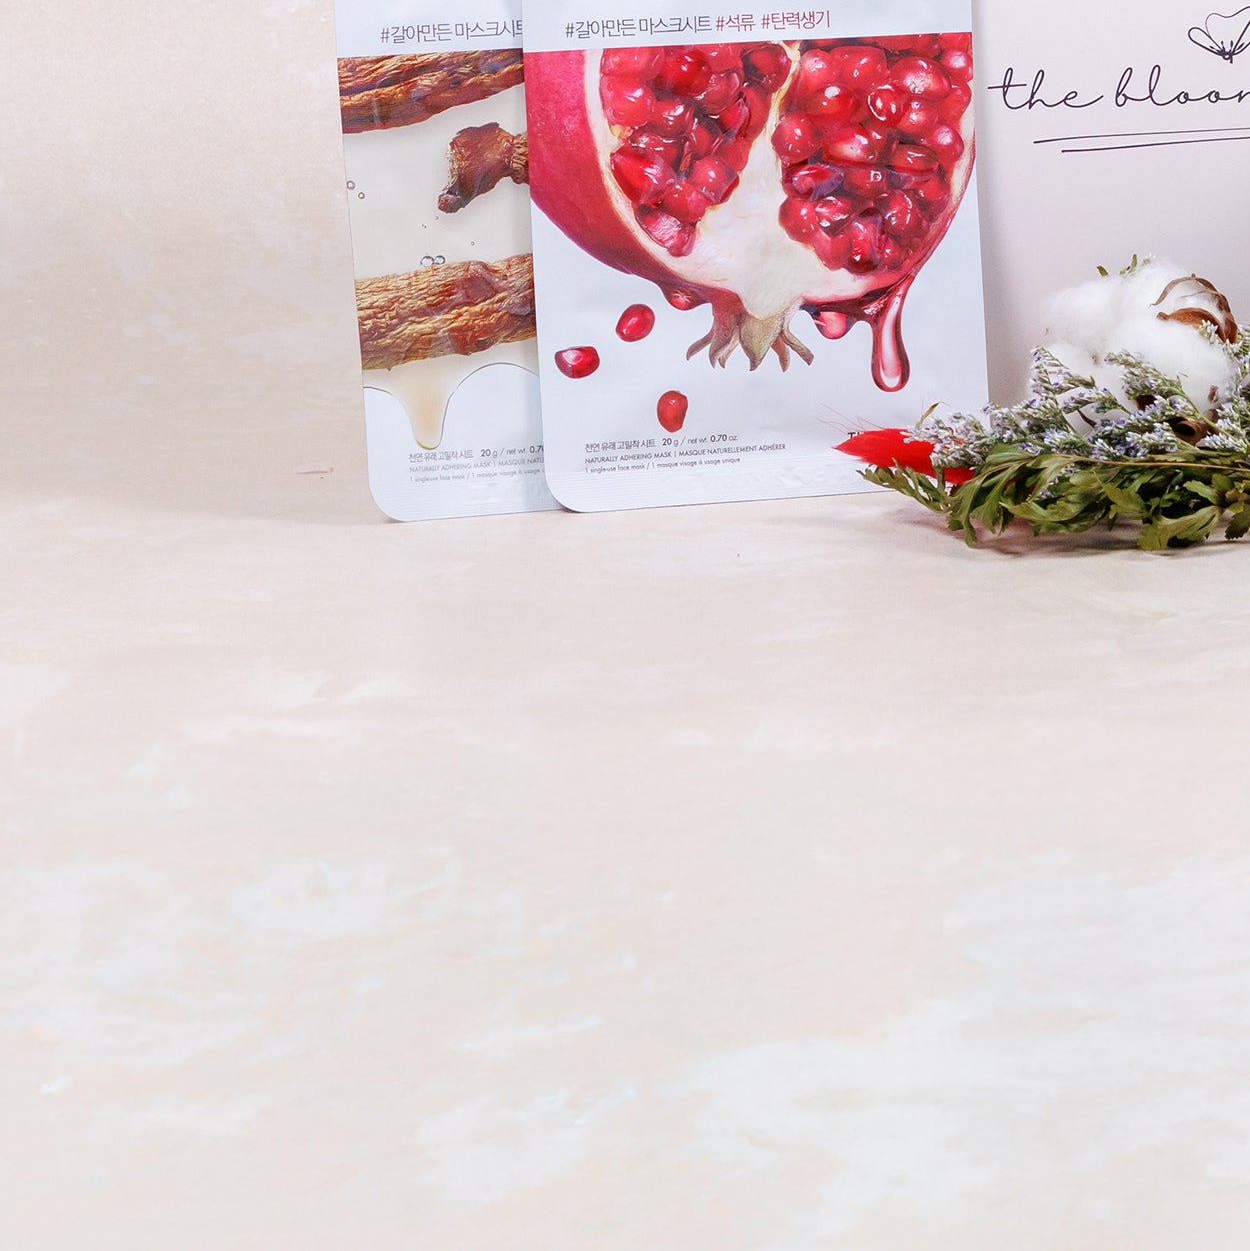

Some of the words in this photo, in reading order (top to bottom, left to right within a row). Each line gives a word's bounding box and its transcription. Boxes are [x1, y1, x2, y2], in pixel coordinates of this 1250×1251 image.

[380, 22, 452, 44] #갈아만든
[565, 18, 637, 39] #갈아만든
[639, 15, 713, 35] 마스크시트
[715, 12, 756, 33] #석류
[761, 9, 831, 31] #탄력생기
[987, 66, 1104, 111] the
[662, 437, 672, 446] 20
[673, 438, 679, 447] g
[687, 437, 697, 445] net
[710, 433, 727, 443] 0.70
[480, 448, 491, 458] 20
[492, 450, 498, 459] g
[585, 455, 618, 464] NATURALLY
[620, 452, 652, 461] ADHERING
[654, 451, 672, 459] MASK
[678, 448, 706, 457] MASQUE
[707, 445, 757, 455] NATURELLEMENT
[631, 462, 645, 470] mask
